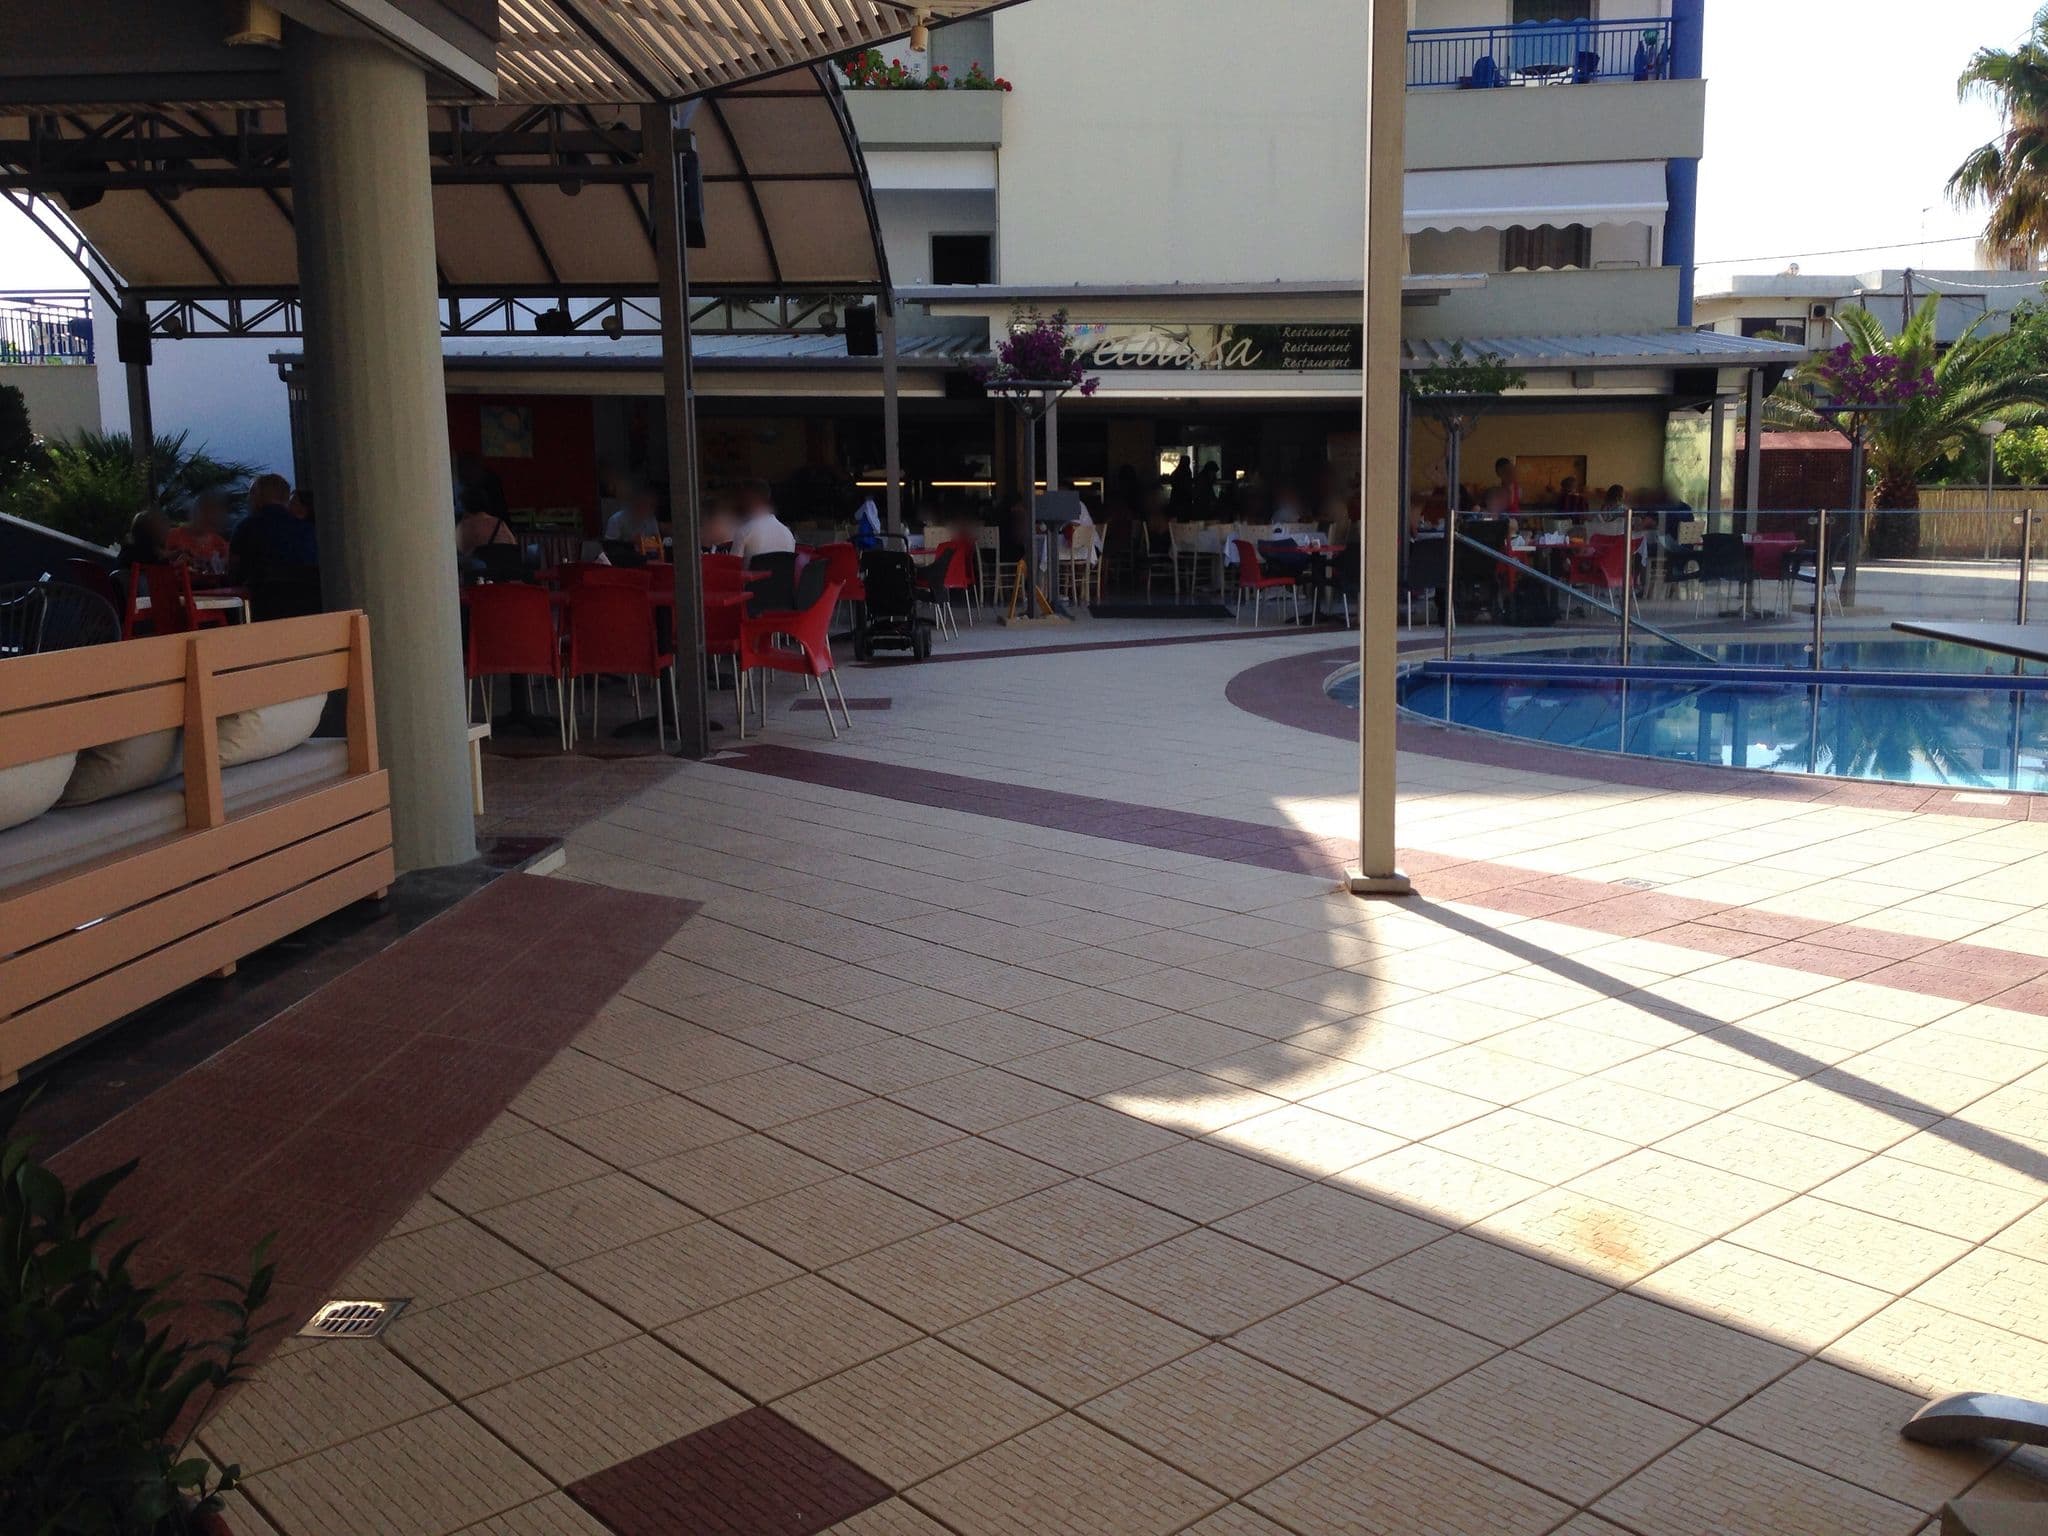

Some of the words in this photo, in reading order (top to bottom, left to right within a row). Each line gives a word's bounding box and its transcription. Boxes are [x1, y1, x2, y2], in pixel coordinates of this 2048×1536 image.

[1282, 326, 1353, 338] Restaurant
[1282, 342, 1353, 353] Restaurant
[1282, 357, 1353, 369] Restaurant
